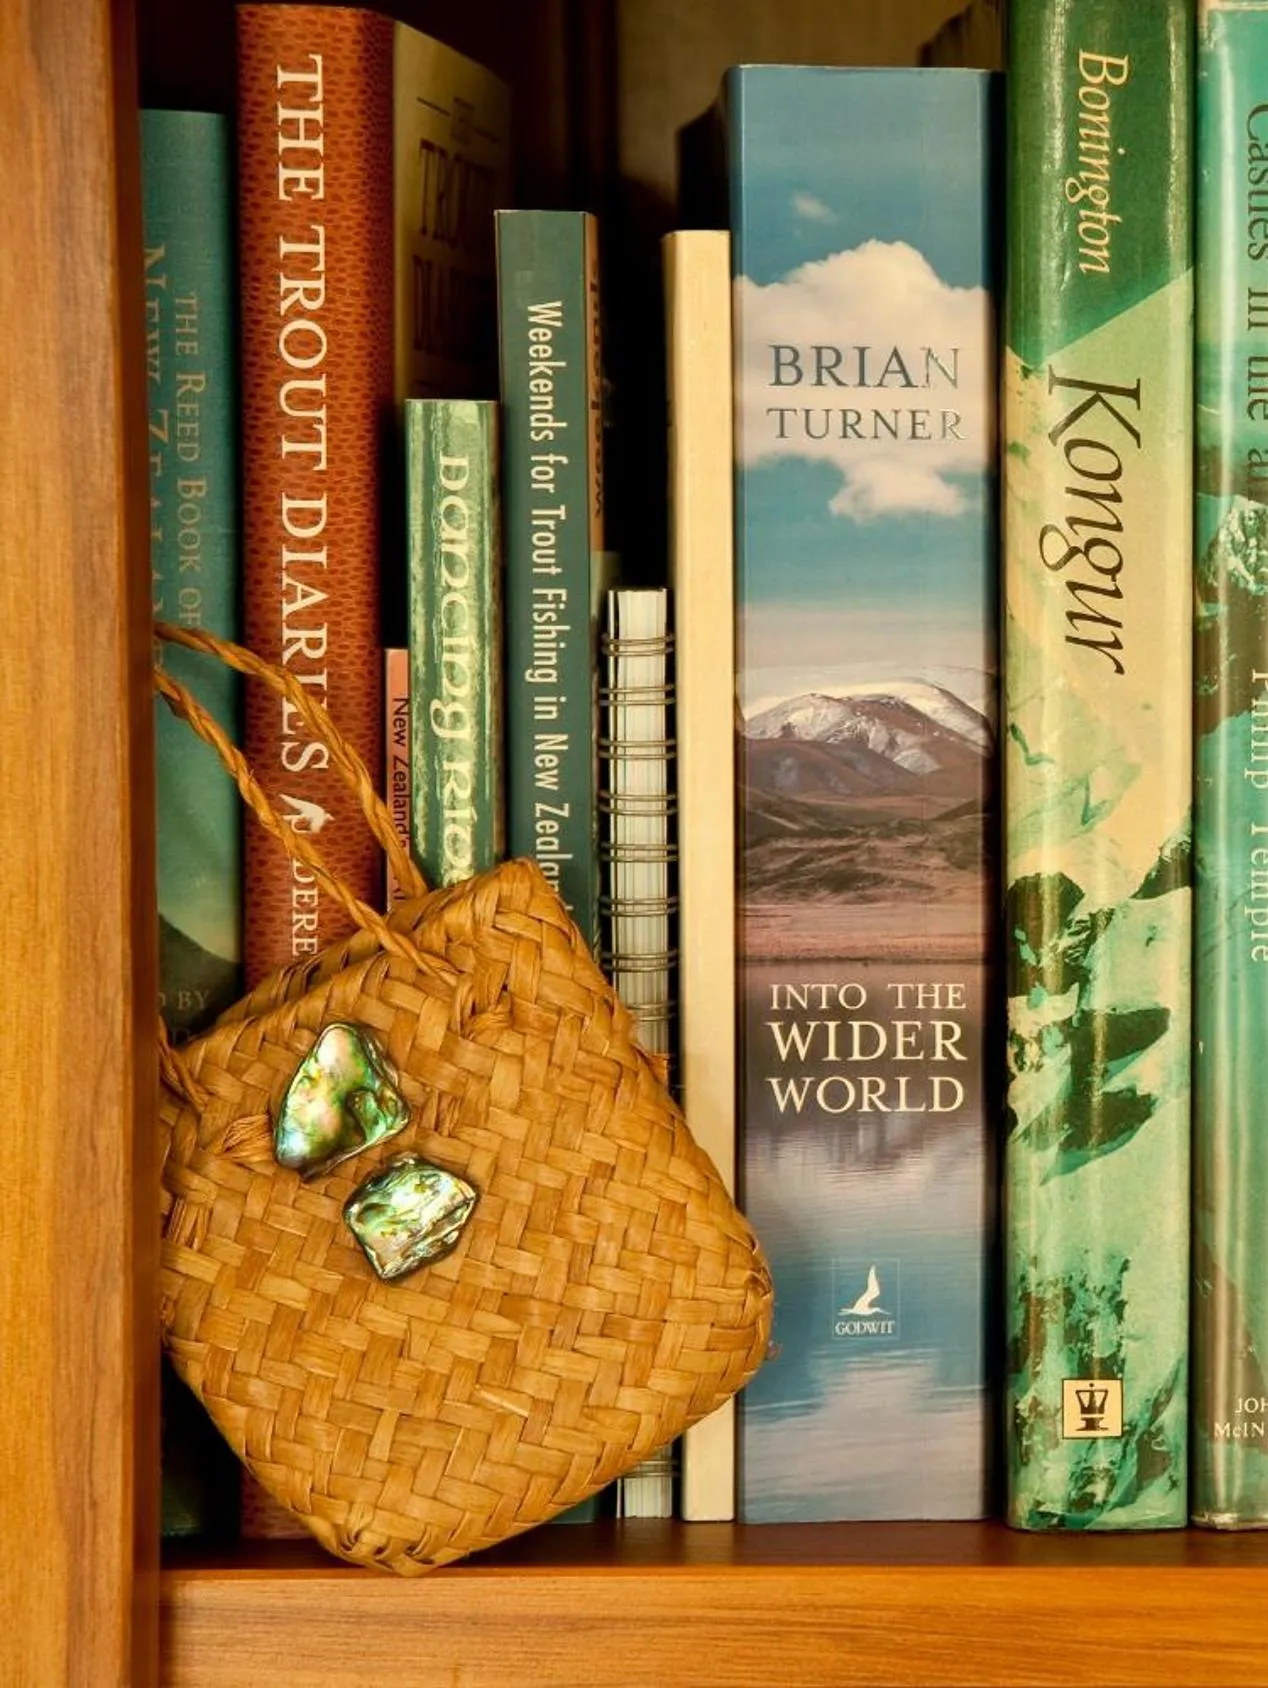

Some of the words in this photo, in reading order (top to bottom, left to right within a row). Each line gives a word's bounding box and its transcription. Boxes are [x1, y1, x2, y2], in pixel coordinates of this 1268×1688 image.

[276, 53, 324, 202] THE
[1065, 48, 1130, 276] Bonington
[175, 293, 200, 355] THE
[278, 225, 328, 472] TROUT
[527, 301, 567, 442] Weekends
[767, 344, 960, 390] BRIAN
[175, 371, 206, 463] REED
[766, 407, 968, 442] TURNER
[530, 452, 569, 493] for
[177, 477, 208, 574] BOOK
[531, 504, 567, 576] Trout
[1038, 362, 1142, 677] Kongur
[280, 491, 330, 773] DIARIES
[525, 588, 571, 685] Fishing
[392, 697, 410, 748] New
[533, 696, 567, 721] in
[533, 733, 570, 792] New
[533, 801, 575, 912] Zeala
[769, 983, 868, 1010] INTO
[887, 983, 967, 1010] THE
[766, 1020, 968, 1062] WIDER
[766, 1075, 966, 1114] WORLD
[834, 1319, 896, 1336] GODWIT
